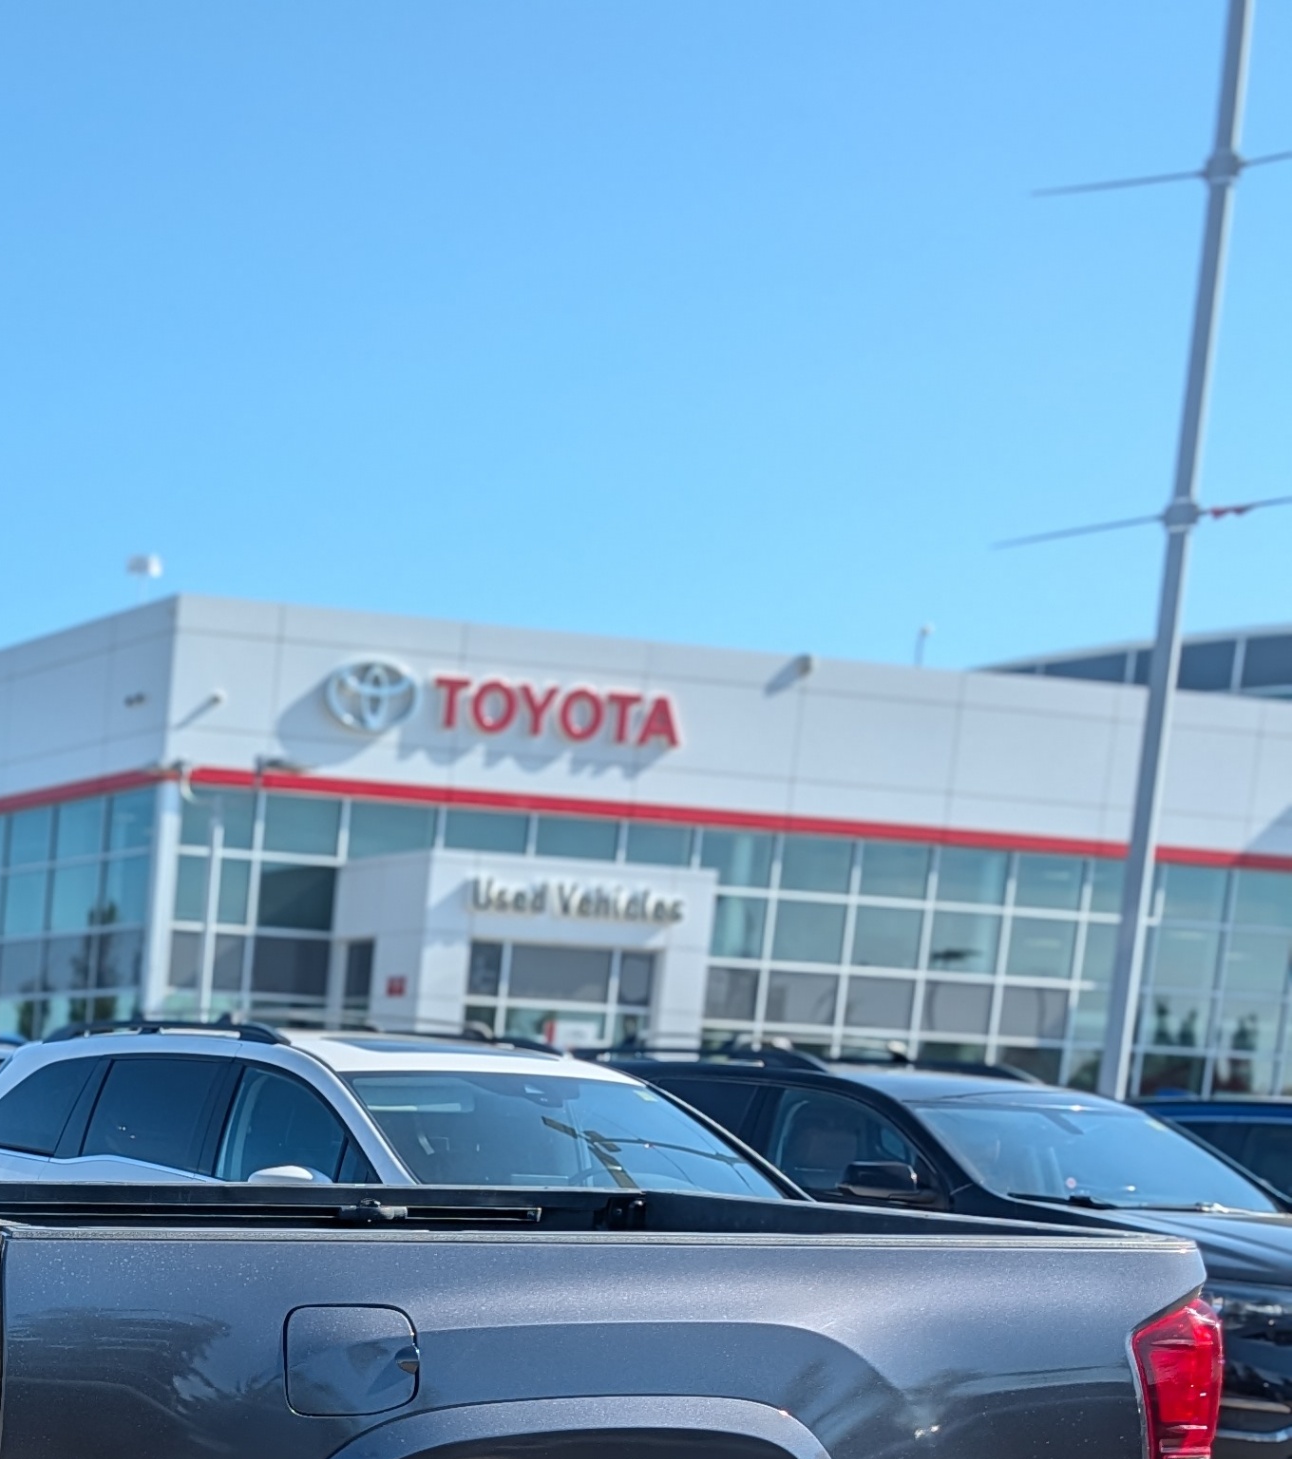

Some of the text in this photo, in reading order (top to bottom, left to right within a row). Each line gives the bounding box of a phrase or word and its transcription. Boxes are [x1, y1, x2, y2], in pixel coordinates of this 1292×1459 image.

[434, 677, 679, 747] TOYOTA
[472, 876, 684, 923] Used Vehicles
